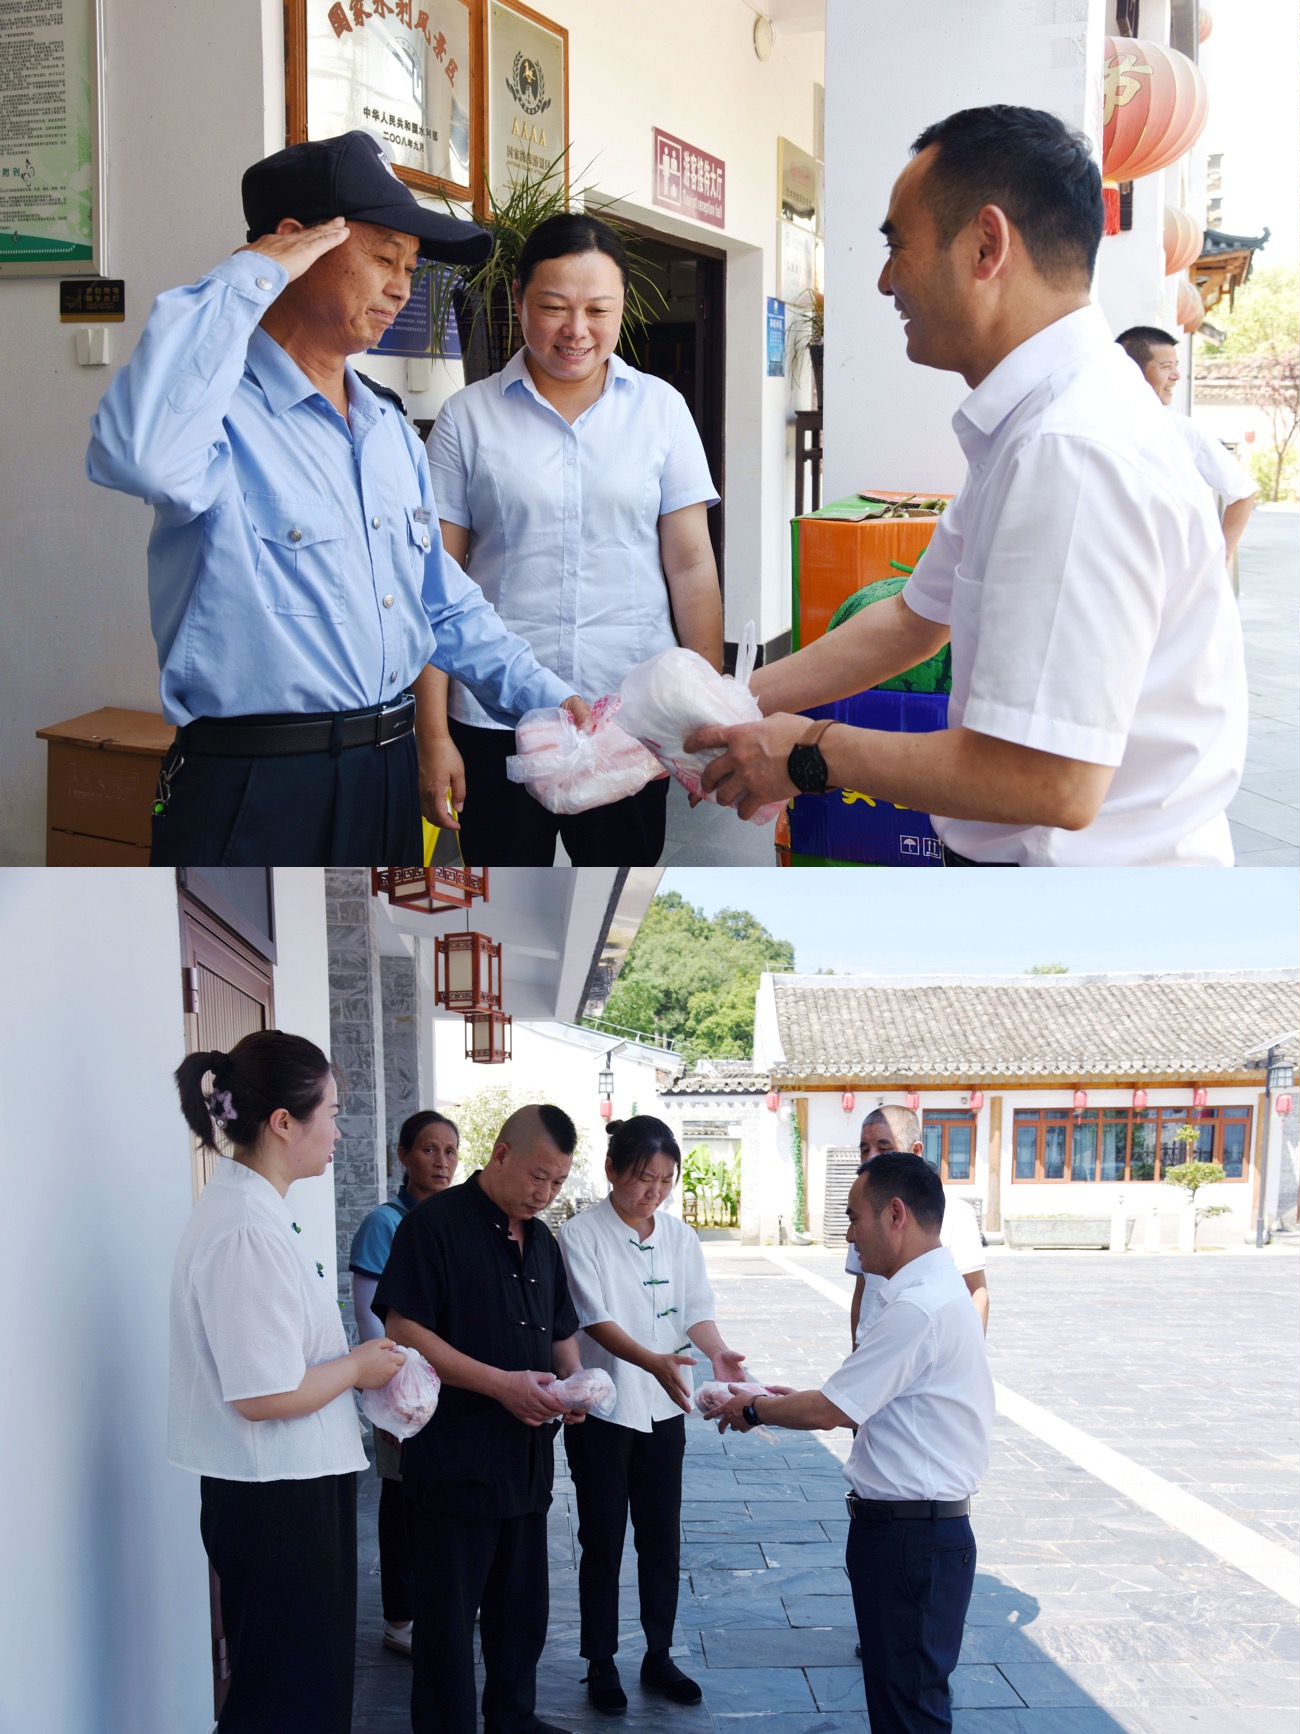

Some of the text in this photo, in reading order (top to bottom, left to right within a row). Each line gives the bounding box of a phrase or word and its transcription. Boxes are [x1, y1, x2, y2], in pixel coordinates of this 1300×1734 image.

[328, 0, 459, 88] 国家水利风景区
[363, 106, 439, 143] 中华人民共和国水利部
[512, 117, 548, 147] AAAA
[683, 151, 723, 201] 游客接待大厅
